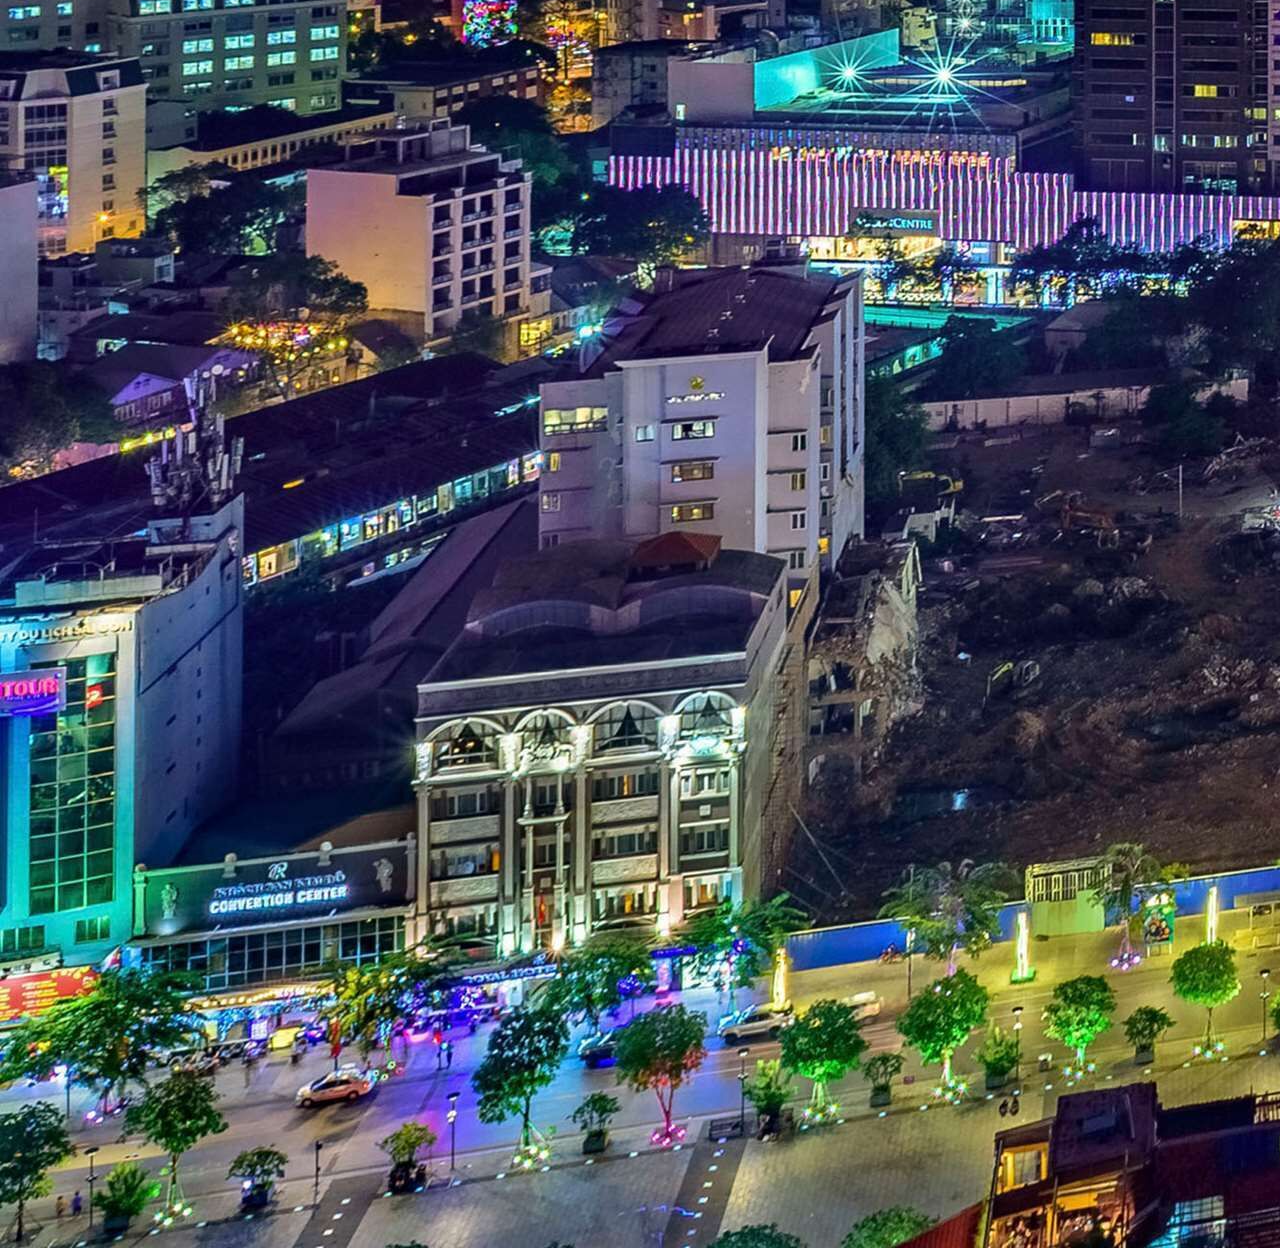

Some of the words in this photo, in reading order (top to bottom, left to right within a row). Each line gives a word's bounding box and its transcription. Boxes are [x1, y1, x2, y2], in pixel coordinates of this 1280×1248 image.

[0, 677, 59, 697] TOUR
[209, 891, 294, 914] CONVENTION
[296, 885, 348, 903] CENTER
